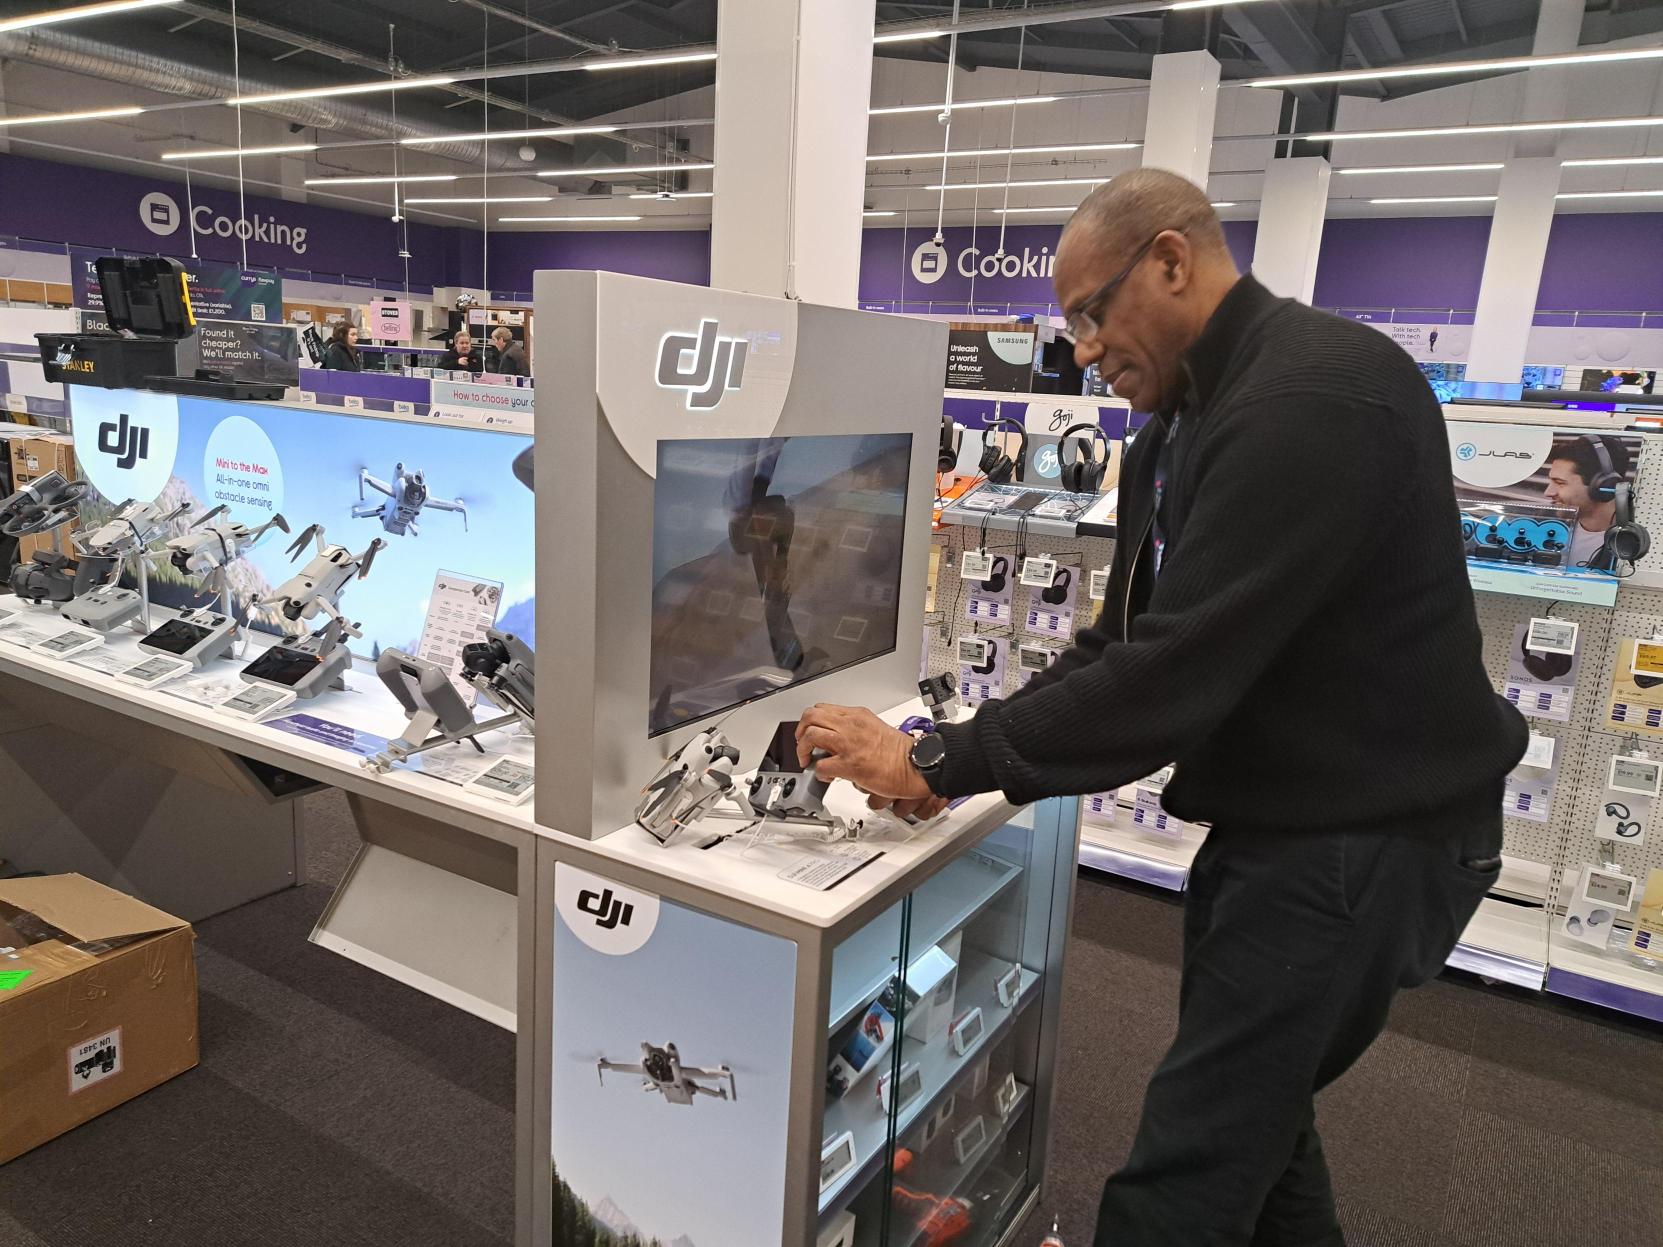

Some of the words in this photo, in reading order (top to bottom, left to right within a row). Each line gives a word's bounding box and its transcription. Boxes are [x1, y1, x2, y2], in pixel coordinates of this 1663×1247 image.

[191, 205, 307, 254] Cooking
[85, 261, 98, 273] Te
[186, 274, 199, 283] er.
[86, 319, 110, 330] Blac
[200, 327, 227, 338] Found
[228, 329, 235, 338] it
[201, 338, 241, 349] cheaper?
[997, 337, 1029, 345] SAMSUNG
[202, 348, 224, 358] We'll
[225, 350, 252, 360] match
[253, 351, 262, 360] it.
[950, 344, 979, 353] Unleash
[956, 354, 978, 362] world
[949, 362, 957, 371] of
[957, 363, 984, 373] flavour
[453, 389, 470, 401] How
[471, 392, 480, 402] to
[481, 392, 510, 405] choose
[511, 399, 529, 408] your
[1048, 407, 1074, 432] goji
[1478, 450, 1533, 460] JLAB
[215, 456, 230, 469] Mini
[230, 461, 239, 471] to
[239, 461, 251, 473] the
[251, 463, 269, 475] Max
[216, 473, 251, 489] All-in-one
[252, 481, 270, 492] omni
[214, 489, 246, 504] obstacle
[247, 496, 273, 511] sensing
[1566, 589, 1583, 597] Sound
[99, 1037, 111, 1048] UN
[79, 1042, 98, 1056] 3481
